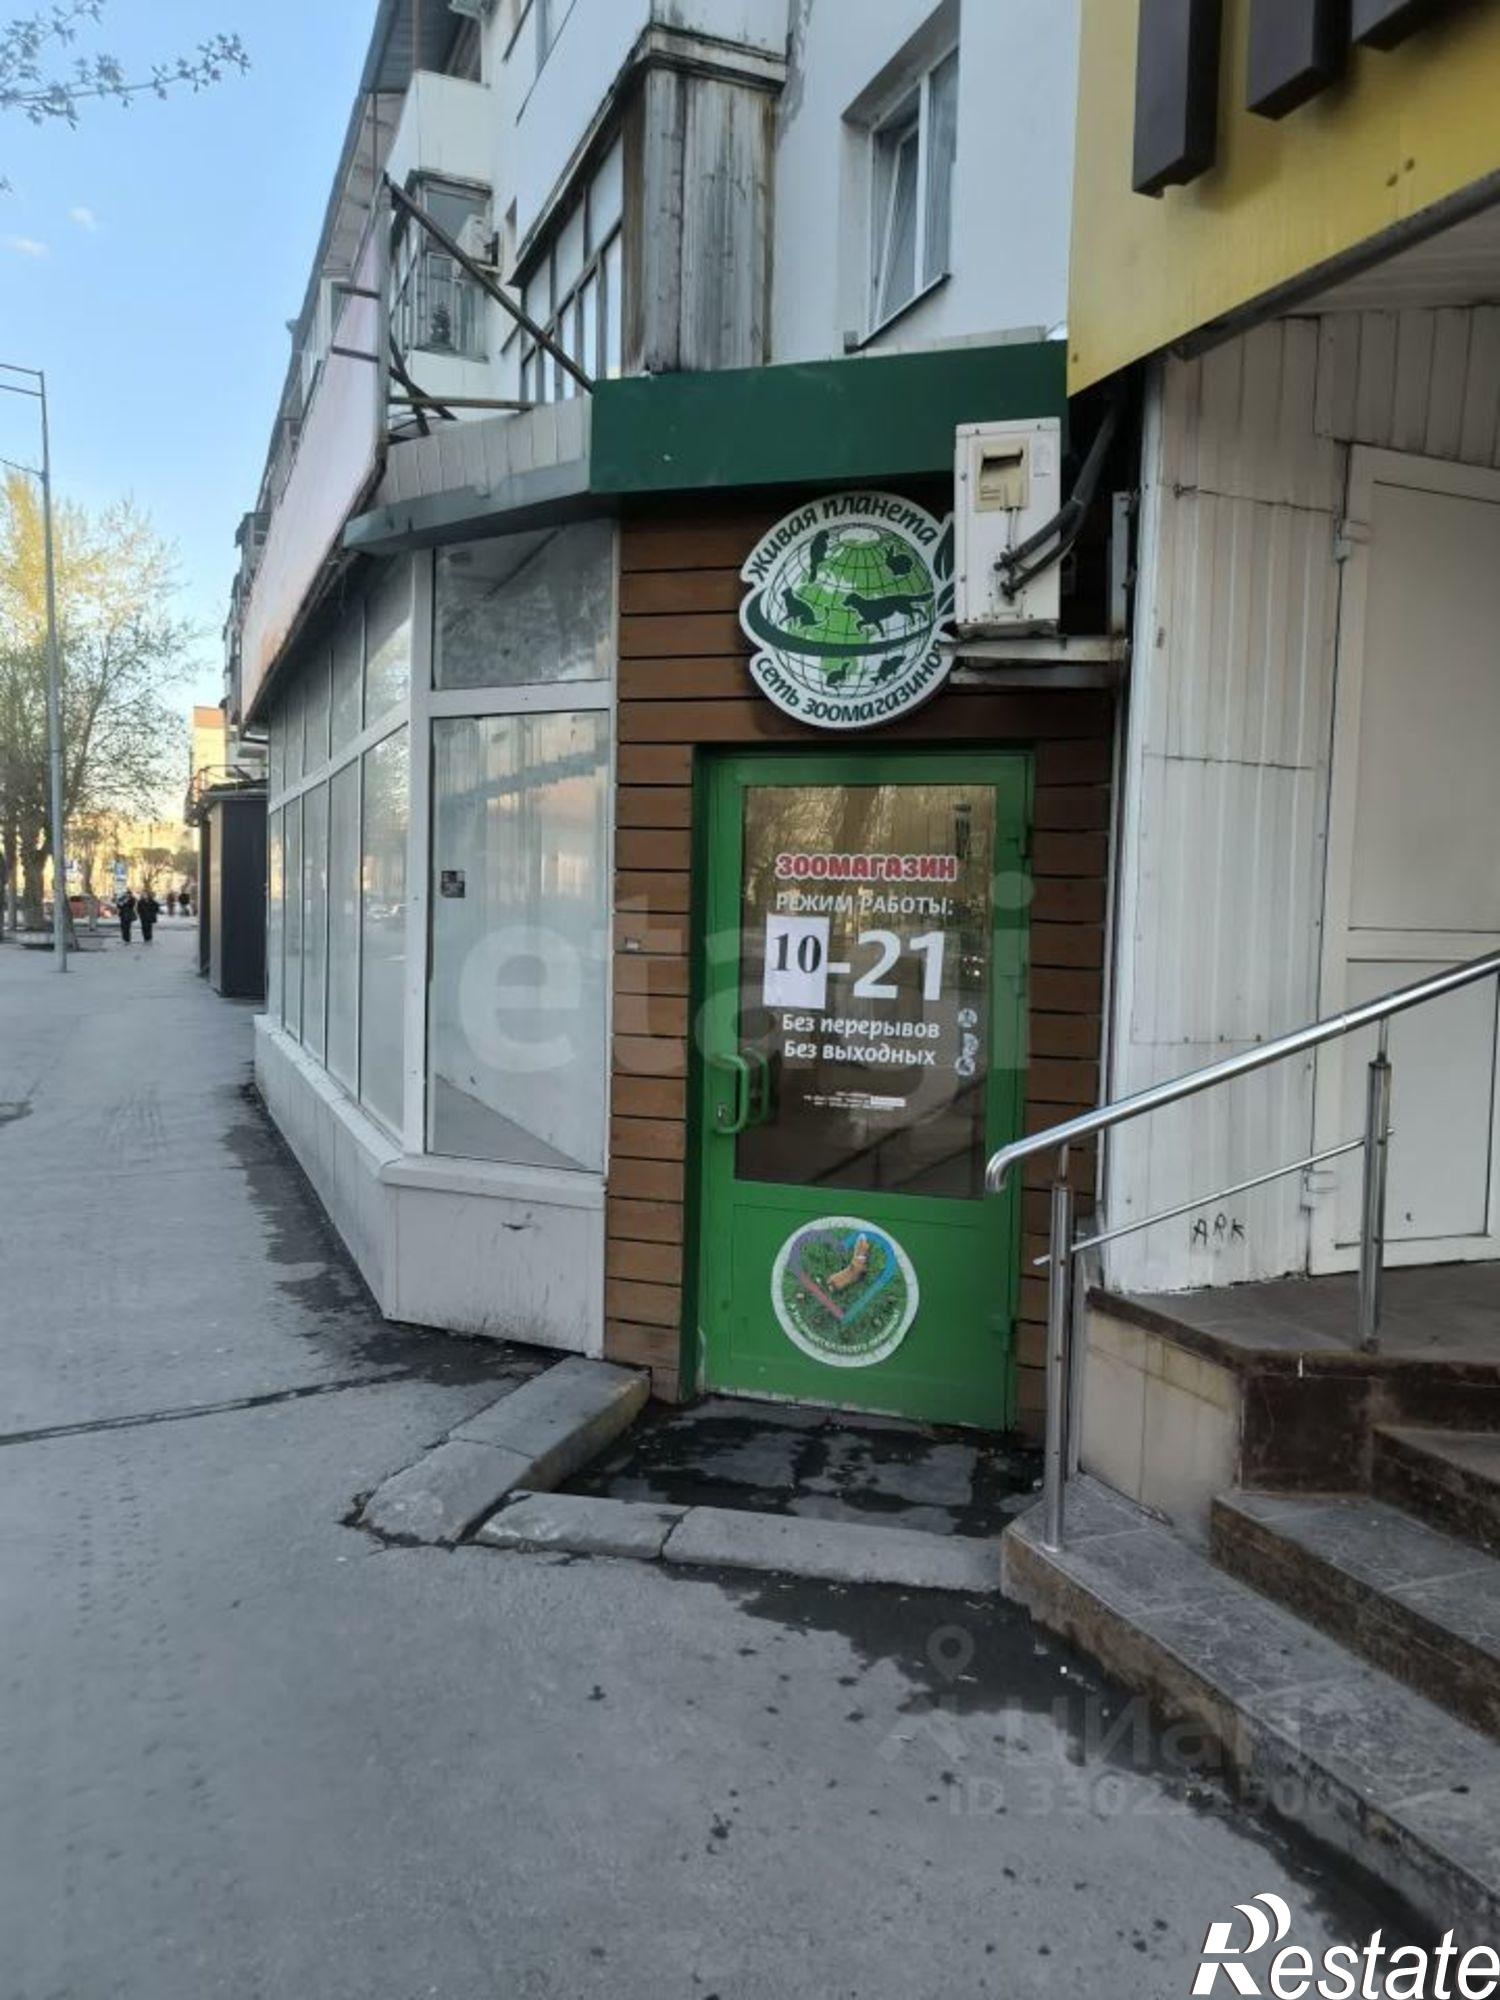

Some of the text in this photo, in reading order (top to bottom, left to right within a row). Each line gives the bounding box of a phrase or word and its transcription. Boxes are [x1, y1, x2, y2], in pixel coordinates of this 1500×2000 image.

[749, 496, 938, 582] Живая планета
[775, 854, 957, 881] ЗООМАГАЗИН
[776, 892, 953, 915] РЕЖИМ РАБОТЫ:
[782, 1014, 940, 1040] Без перерывов
[784, 1041, 936, 1066] Без выходных
